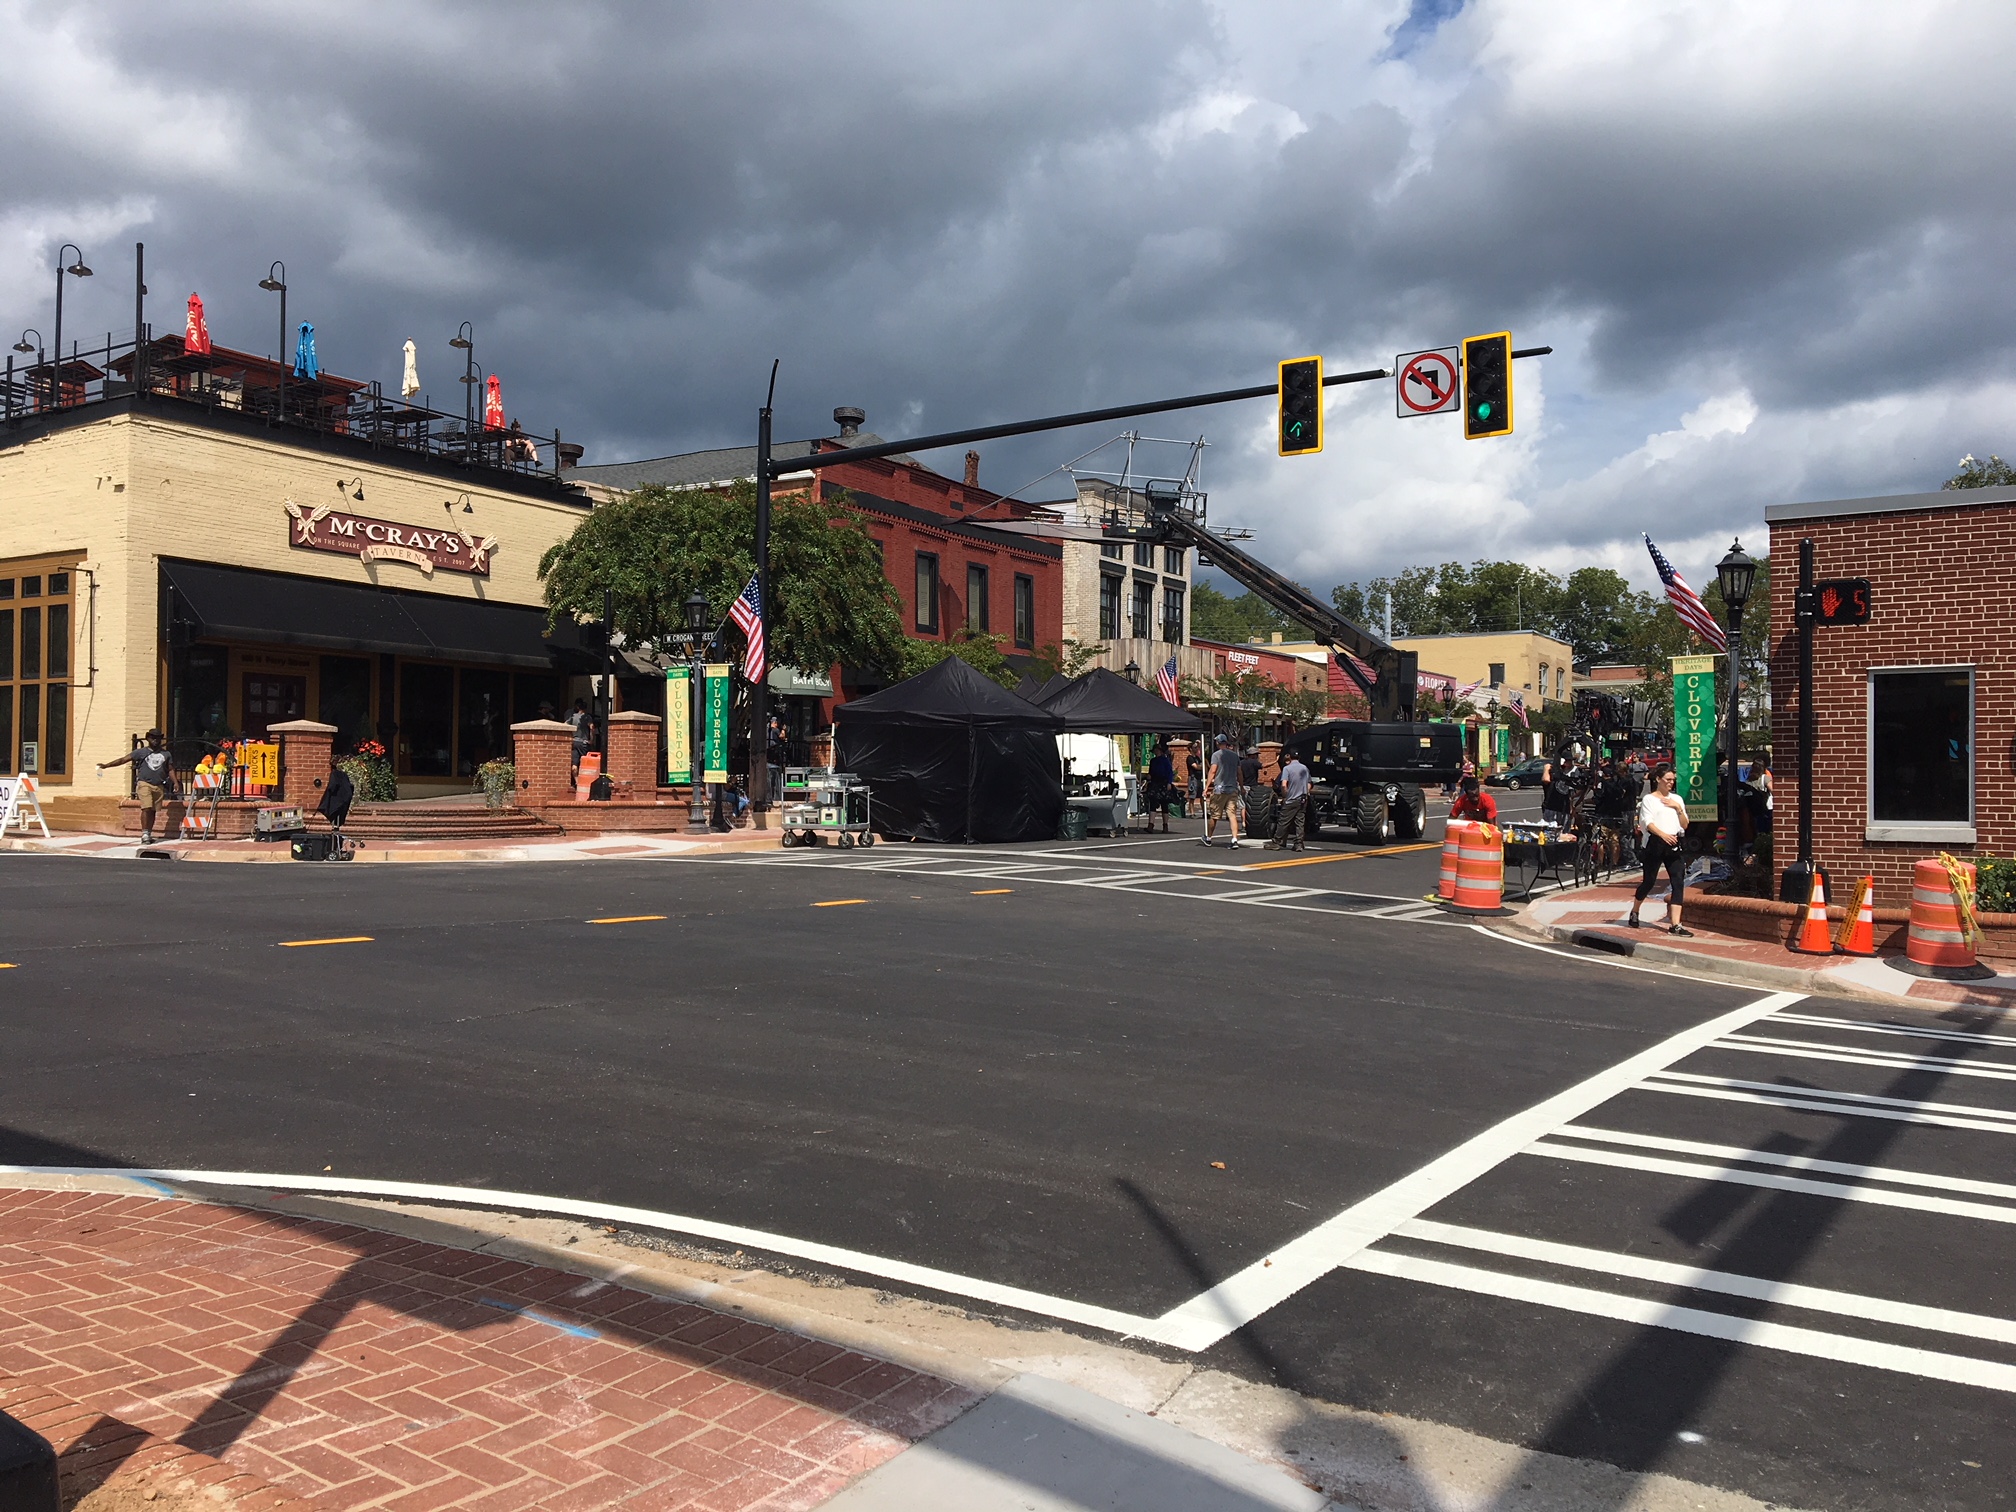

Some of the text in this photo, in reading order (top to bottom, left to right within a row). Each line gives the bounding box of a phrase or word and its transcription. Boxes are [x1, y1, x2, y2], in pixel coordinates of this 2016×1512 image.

[323, 538, 336, 546] THE
[337, 541, 360, 550] SQUARE
[373, 547, 421, 562] TAVERN
[452, 557, 466, 566] 2007
[1854, 589, 1866, 616] 5
[672, 633, 694, 642] CROGAN
[1228, 651, 1260, 666] FLEET FEET
[1675, 657, 1712, 665] HERITAGE
[792, 676, 814, 685] BATH
[674, 680, 683, 769] CLOVERTON
[712, 678, 722, 769] CLOVERTON
[1687, 675, 1704, 801] CLOVERTON
[251, 749, 259, 778] TRUCKS
[268, 751, 276, 780] TRUCKS
